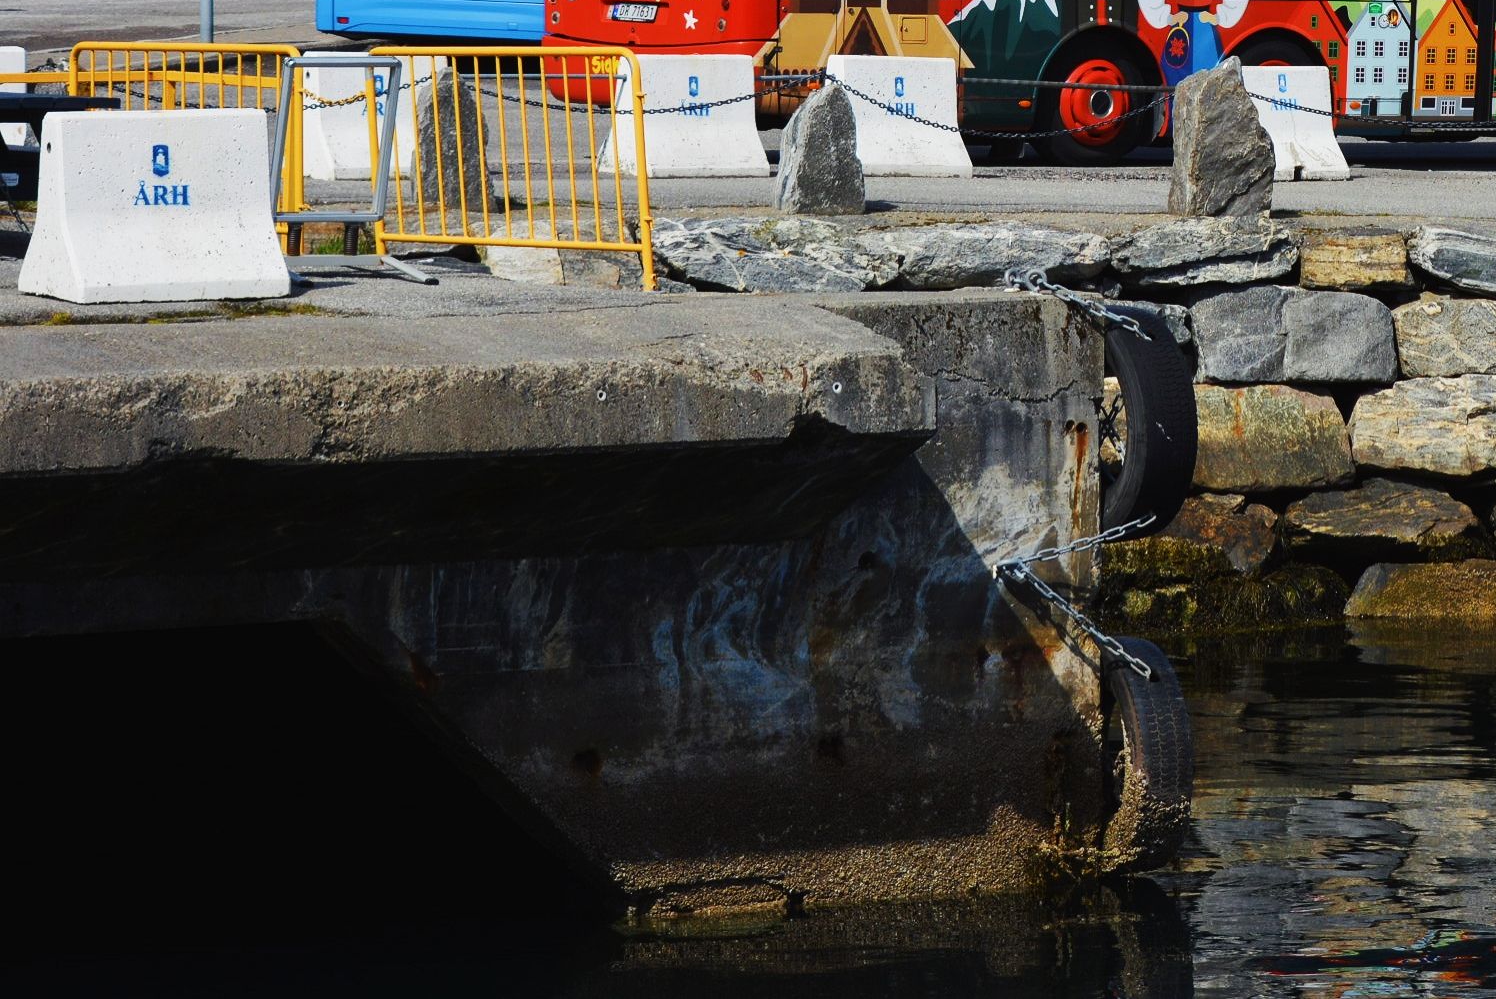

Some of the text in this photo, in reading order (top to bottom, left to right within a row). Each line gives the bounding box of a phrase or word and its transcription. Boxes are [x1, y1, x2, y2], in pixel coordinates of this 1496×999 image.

[619, 5, 654, 18] DR 71631
[134, 181, 190, 206] ÅRH
